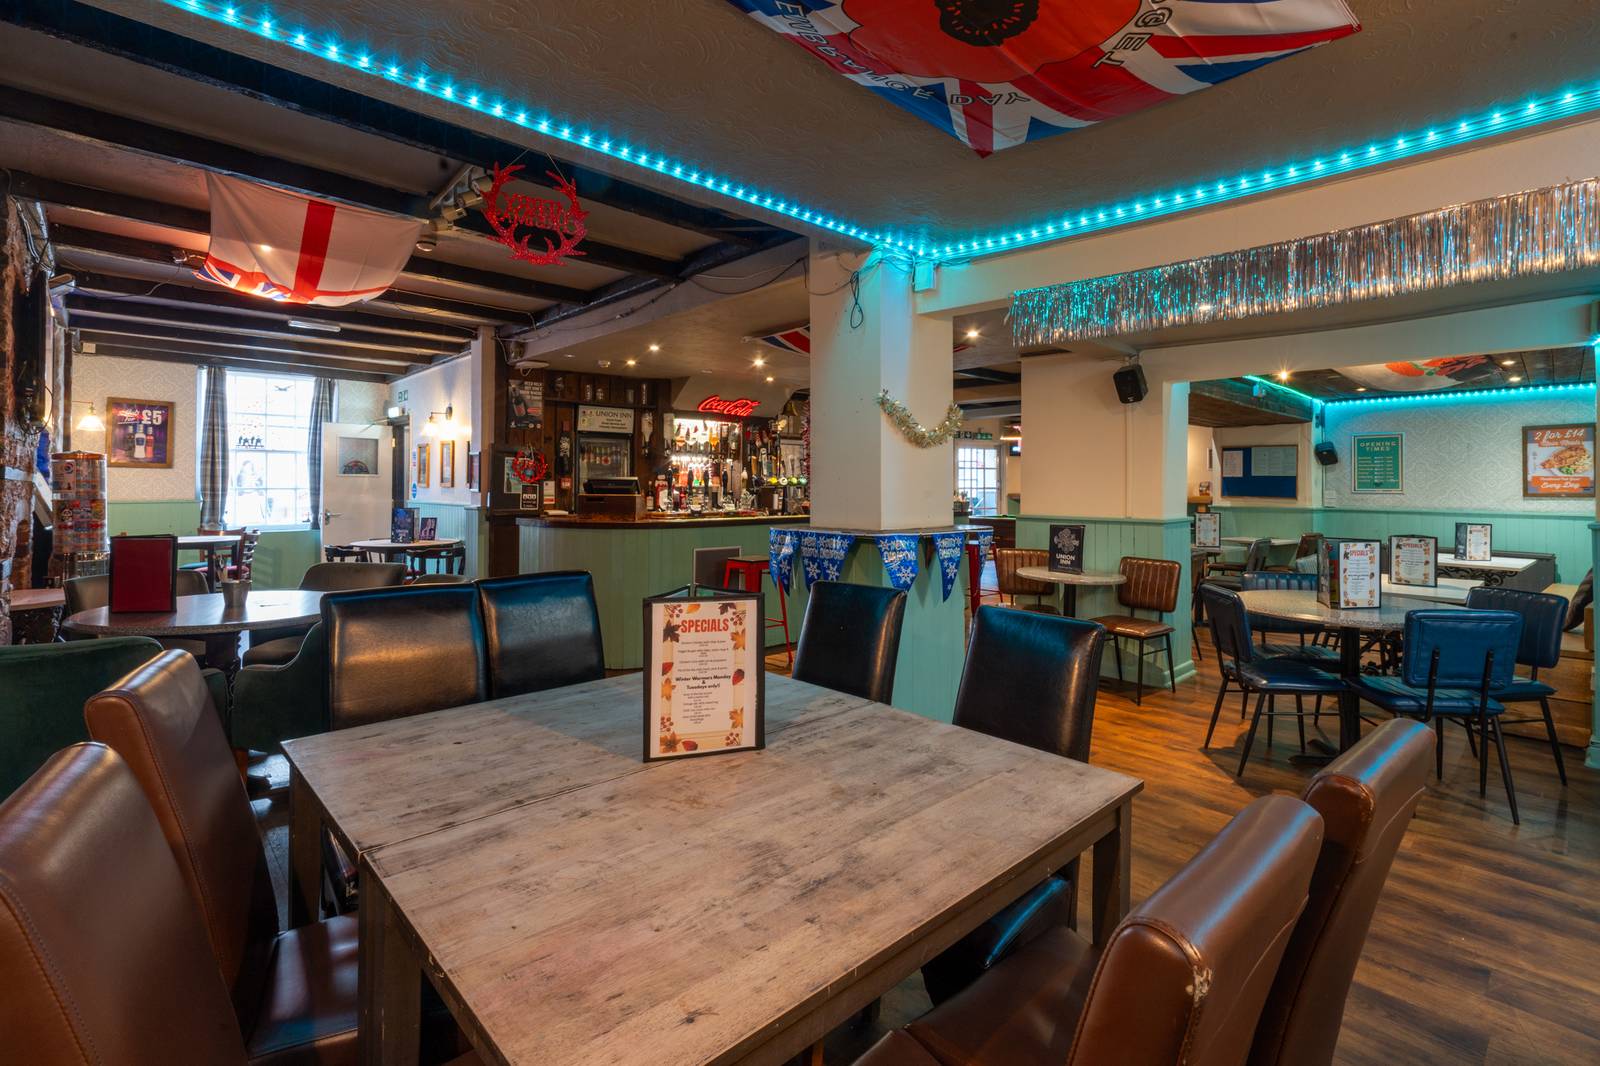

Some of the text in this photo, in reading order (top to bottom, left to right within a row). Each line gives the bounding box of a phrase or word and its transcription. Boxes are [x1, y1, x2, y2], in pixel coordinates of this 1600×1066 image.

[595, 410, 619, 418] UNION
[1534, 431, 1542, 440] 2
[1350, 549, 1369, 557] SPECIALS
[680, 618, 729, 633] SPECIALS
